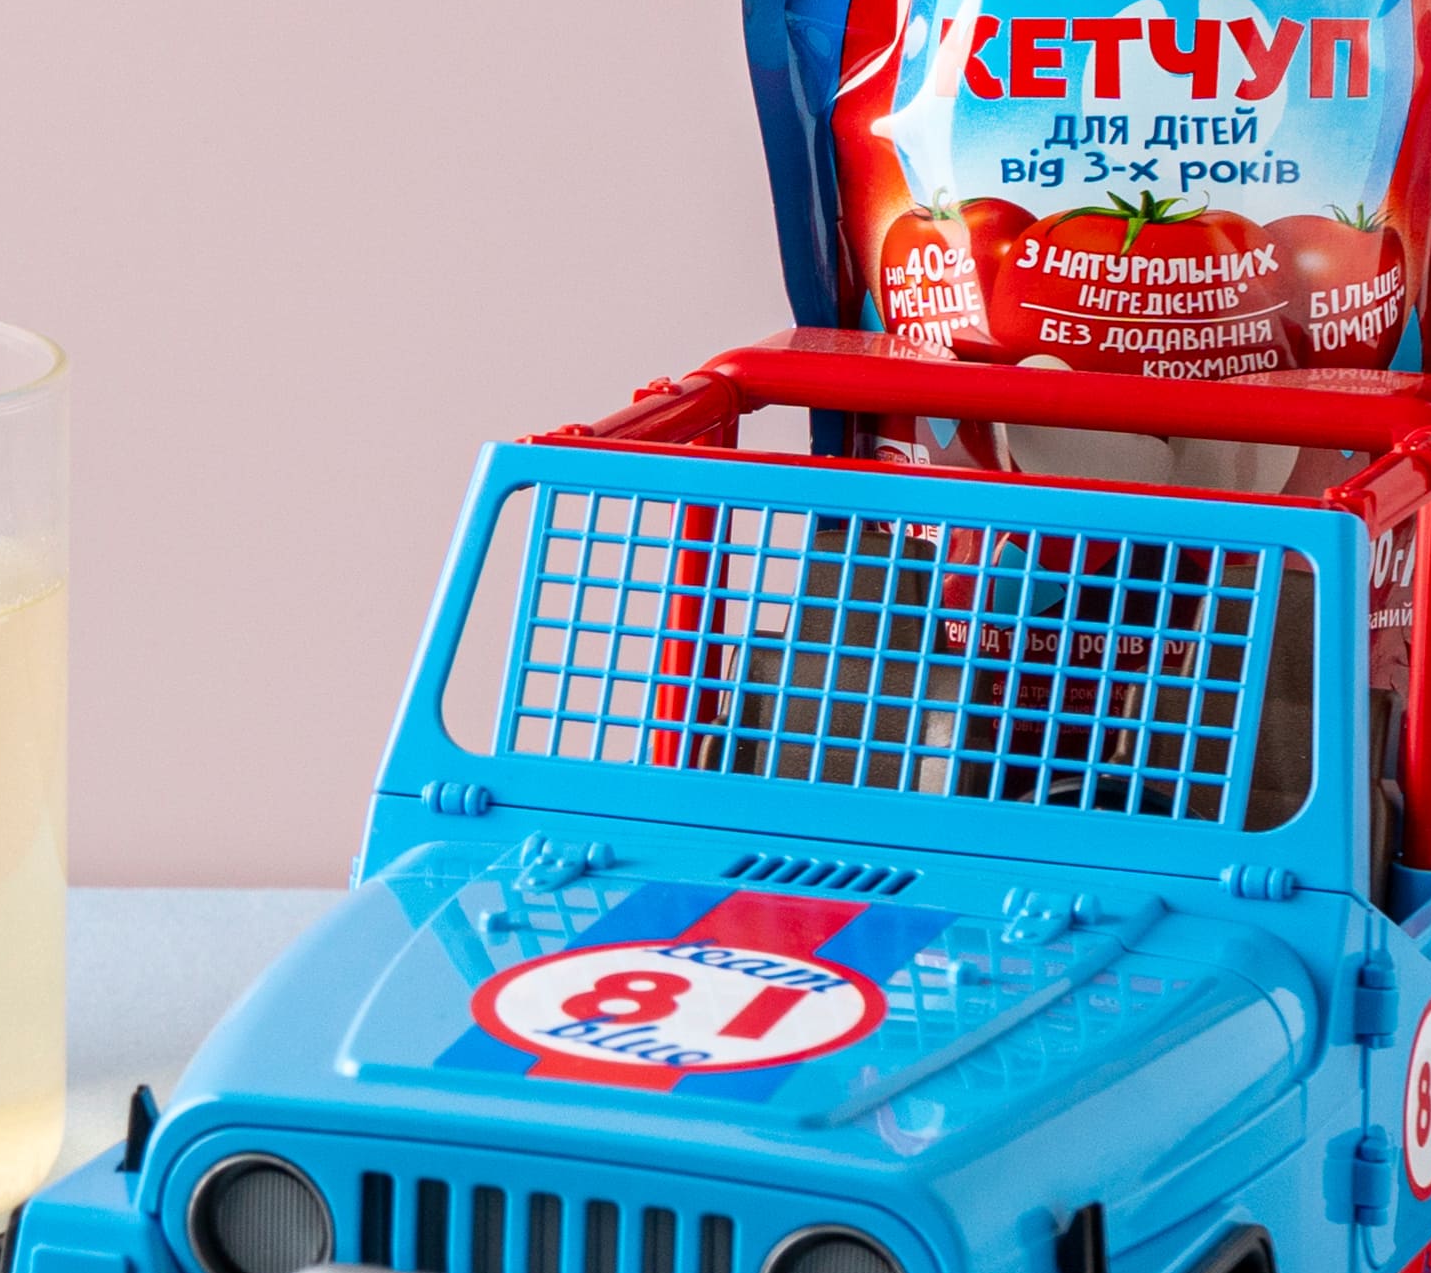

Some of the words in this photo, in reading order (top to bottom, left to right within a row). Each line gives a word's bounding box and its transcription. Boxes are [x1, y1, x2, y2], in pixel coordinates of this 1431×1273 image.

[936, 15, 1371, 101] КЕТЧУП
[1044, 114, 1130, 150] ДЛЯ
[1000, 148, 1065, 188] від
[1179, 150, 1302, 192] років
[904, 243, 976, 285] 40%
[1042, 242, 1280, 286] НАТУРАЛЬНИХ
[889, 280, 982, 320] МЕНШЕ
[1309, 264, 1400, 320] БІЛЬШЕ
[1039, 317, 1093, 346] БЕЗ
[1098, 318, 1274, 355] ДОДАВАННЯ
[1142, 348, 1279, 381] КРОХМАЛЮ
[560, 970, 813, 1041] 81
